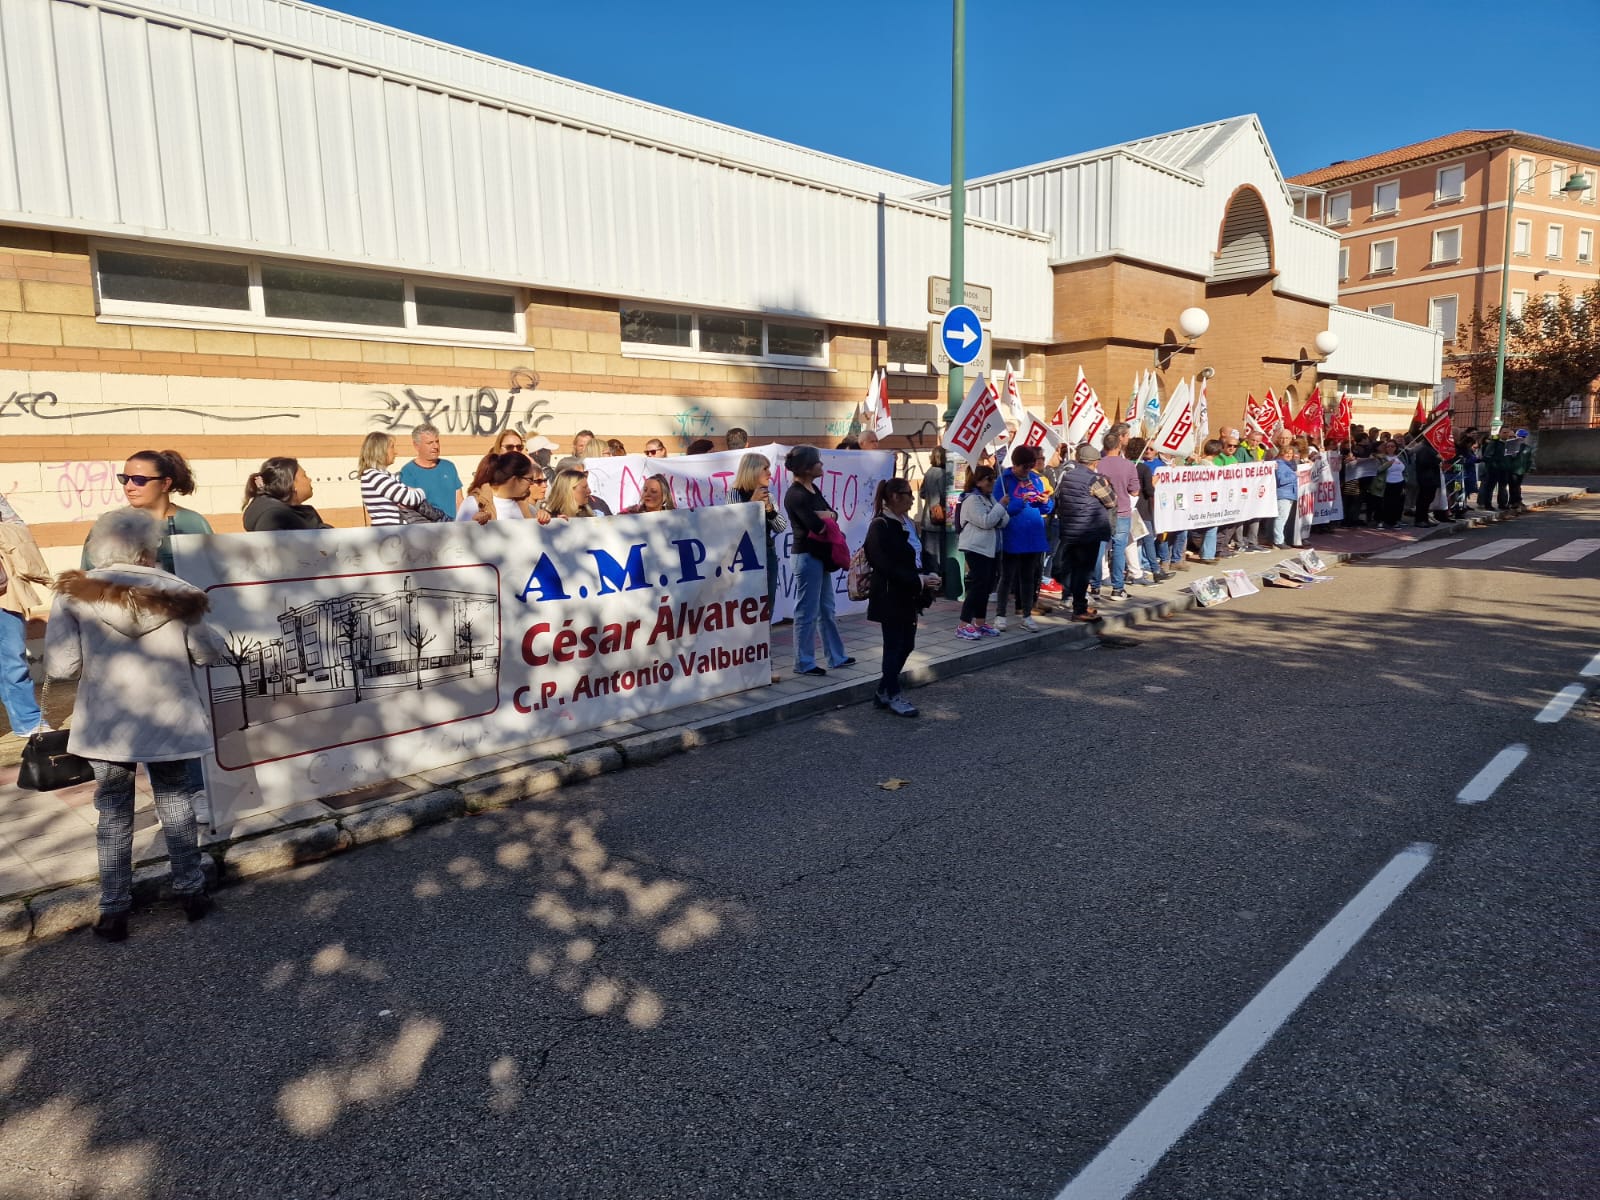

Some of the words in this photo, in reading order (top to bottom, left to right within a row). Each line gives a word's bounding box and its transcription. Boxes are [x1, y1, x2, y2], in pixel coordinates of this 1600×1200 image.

[1245, 467, 1255, 478] DE
[522, 619, 641, 666] César
[647, 595, 770, 646] Álvarez
[513, 681, 565, 713] C.P.
[572, 660, 674, 702] Antonio
